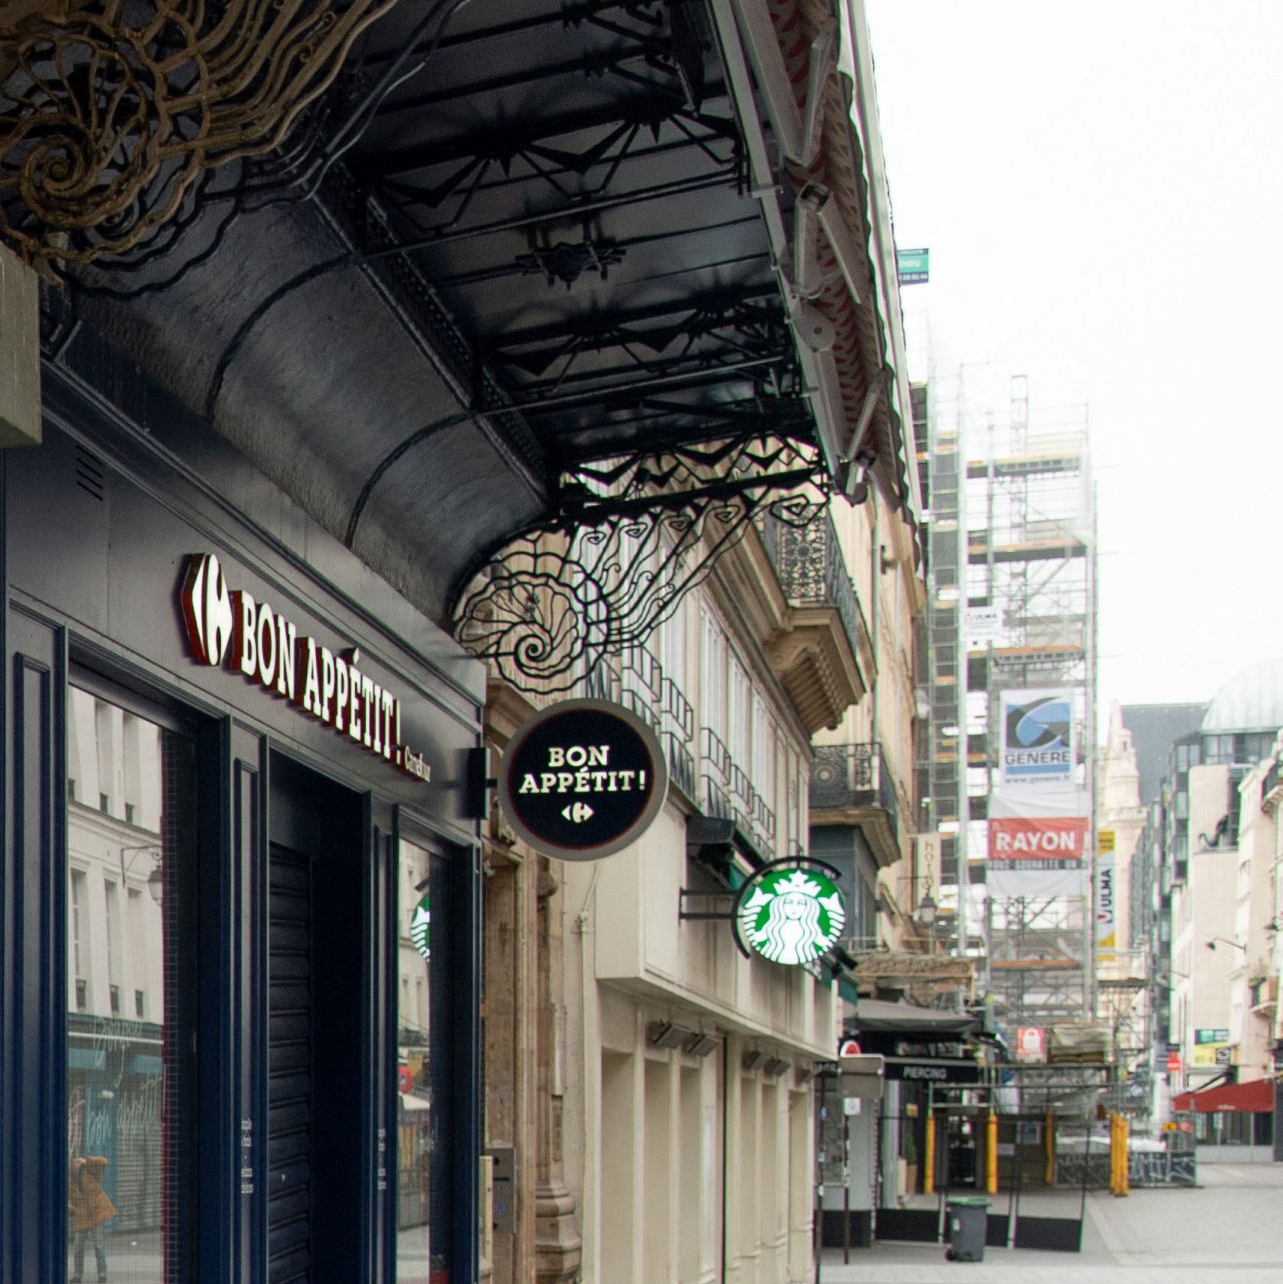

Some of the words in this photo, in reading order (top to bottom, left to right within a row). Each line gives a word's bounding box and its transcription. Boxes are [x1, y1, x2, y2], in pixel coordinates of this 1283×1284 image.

[240, 590, 296, 700] BON
[548, 745, 610, 767] BON
[1005, 751, 1070, 765] GENERE
[995, 831, 1075, 851] RAYON
[1100, 869, 1112, 908] ULMA
[903, 1067, 947, 1079] PIERCING
